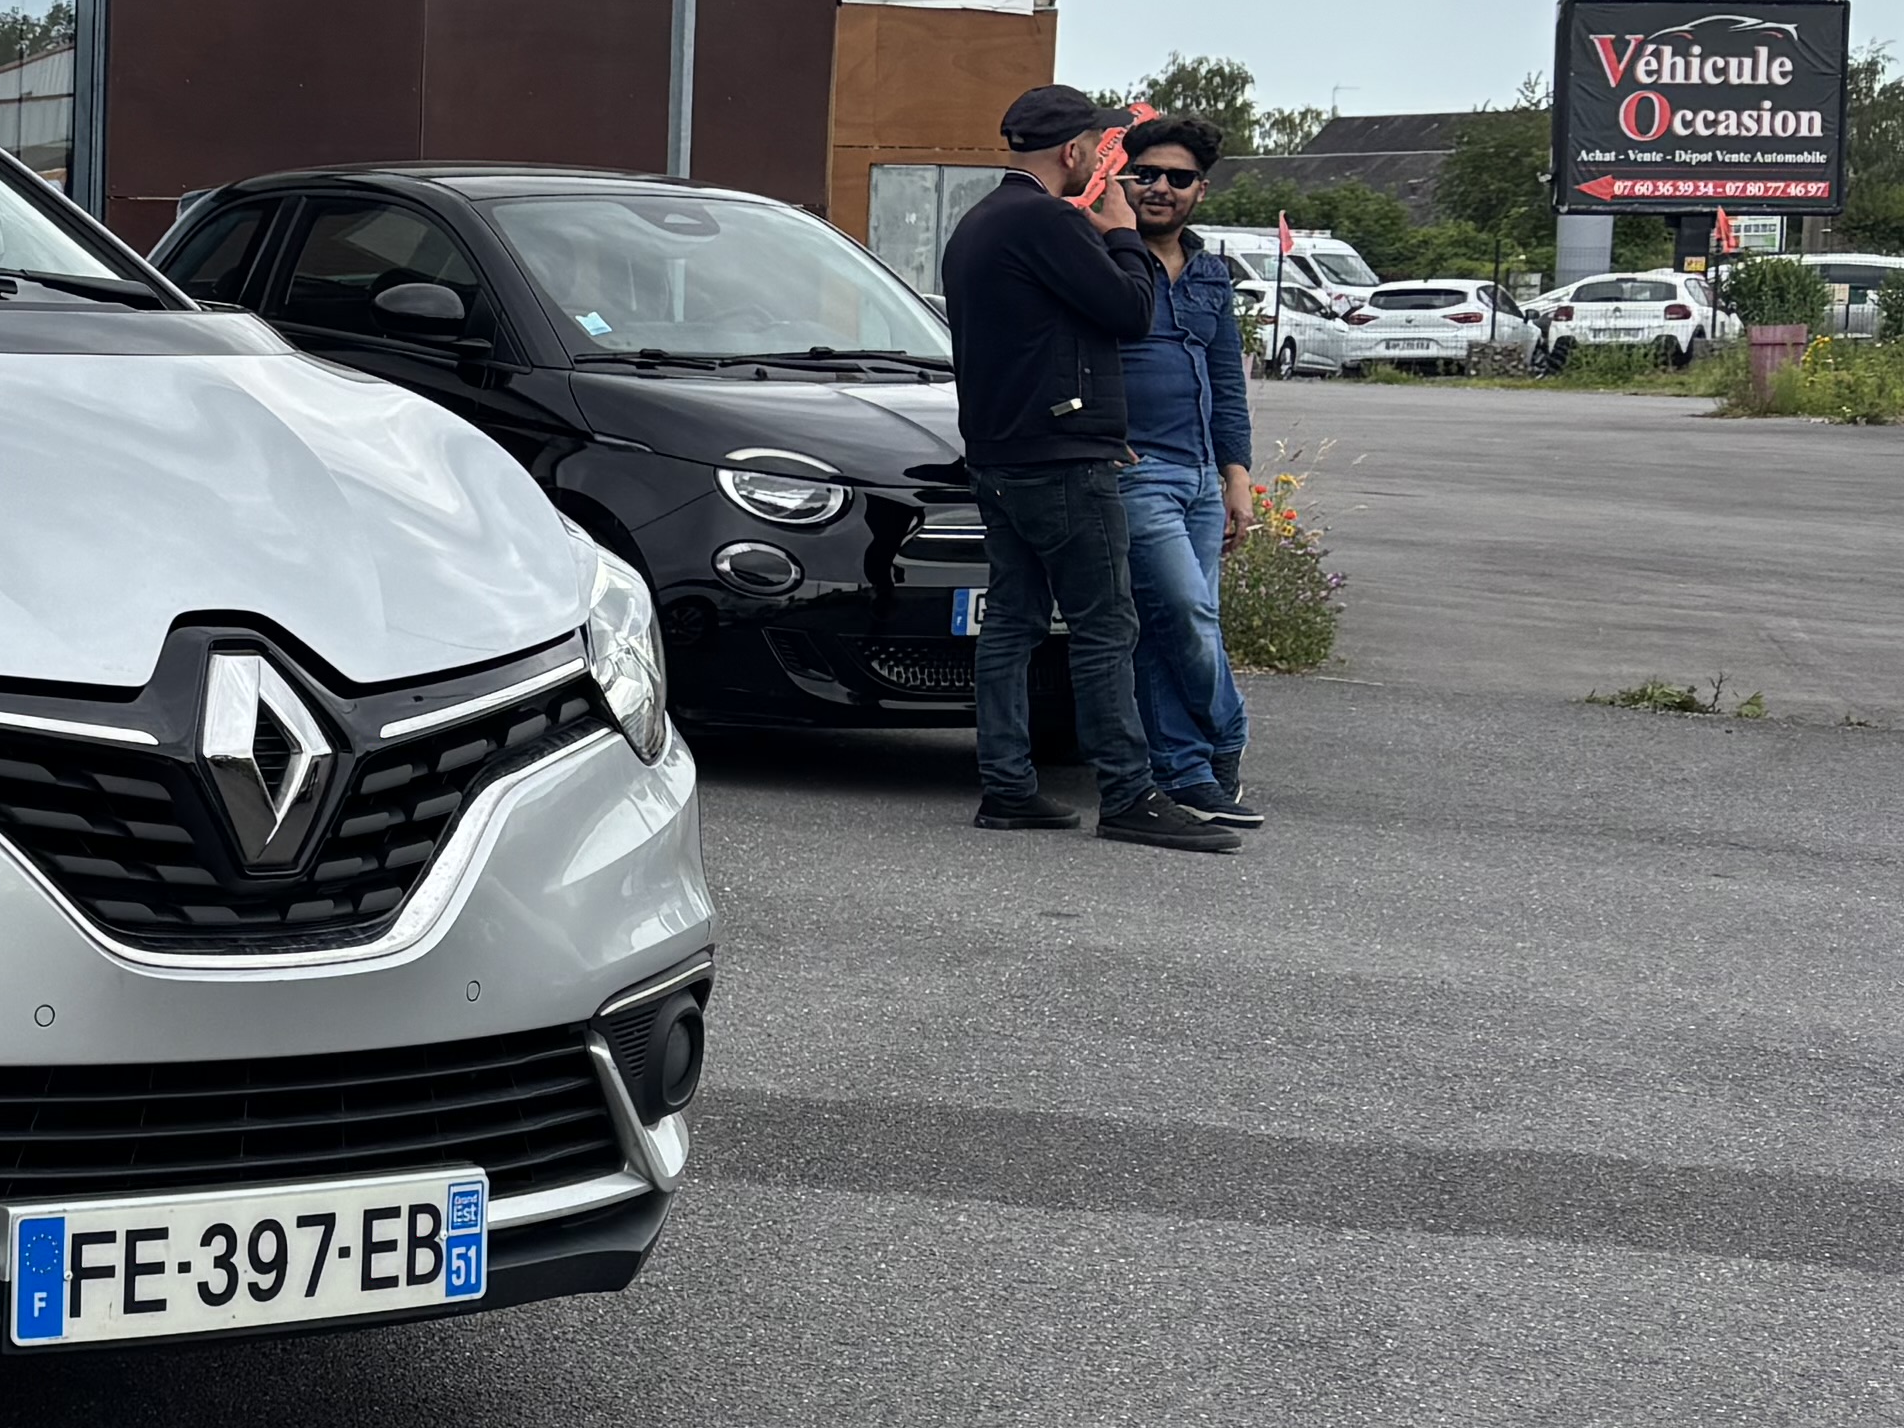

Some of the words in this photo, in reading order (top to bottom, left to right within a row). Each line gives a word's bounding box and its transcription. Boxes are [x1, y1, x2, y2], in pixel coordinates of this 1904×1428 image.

[1588, 33, 1793, 89] Véhicule
[1618, 90, 1824, 142] Occasion
[1577, 149, 1616, 163] Achat
[1627, 149, 1664, 163] Vente
[1715, 150, 1751, 164] Vente
[1753, 151, 1828, 164] Automobile
[1613, 181, 1632, 197] 07
[1634, 181, 1653, 197] 60
[1656, 181, 1674, 197] 36
[1676, 181, 1694, 197] 39
[1695, 181, 1714, 197] 34
[1725, 181, 1743, 197] 07
[1746, 181, 1764, 197] 80
[1766, 181, 1785, 197] 77
[1787, 181, 1806, 197] 46
[1807, 181, 1826, 197] 97
[453, 1203, 477, 1223] Est
[67, 1202, 445, 1319] FE-397-EB
[451, 1244, 477, 1287] 51
[33, 1291, 48, 1317] F
